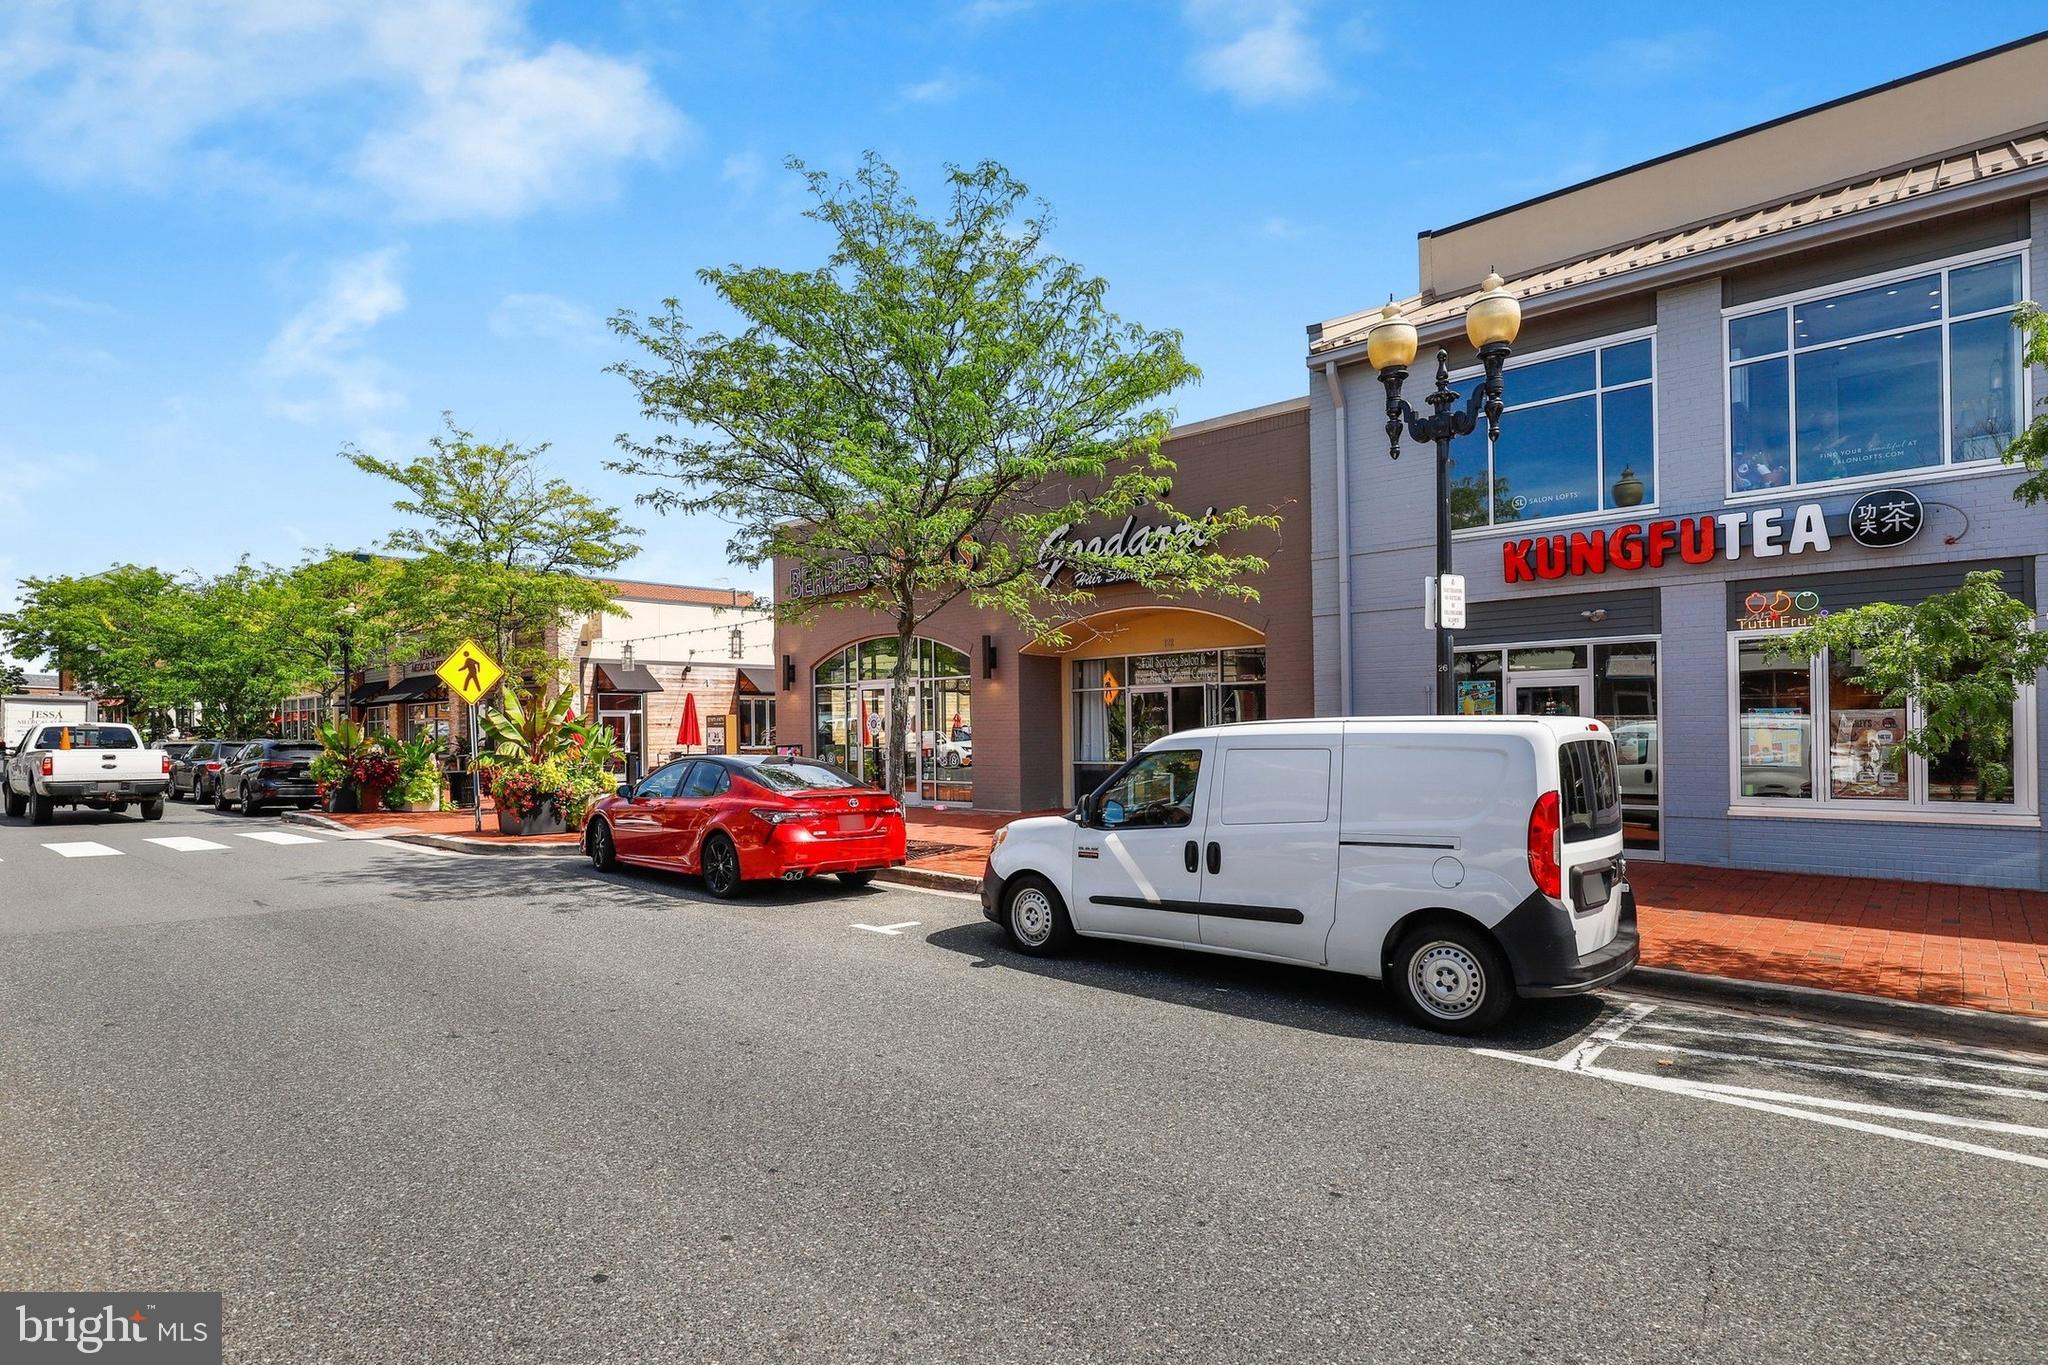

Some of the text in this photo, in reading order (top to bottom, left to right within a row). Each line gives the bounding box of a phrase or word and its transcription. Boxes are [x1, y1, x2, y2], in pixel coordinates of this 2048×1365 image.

[1832, 450, 1905, 466] SALONLOFTS.COM
[1840, 448, 1862, 456] YOUR
[1529, 495, 1553, 505] SALON
[1555, 491, 1578, 500] LOFTS
[1074, 571, 1102, 586] Hair
[1736, 616, 1777, 630] Tutti
[1141, 656, 1154, 669] Full
[1155, 655, 1179, 669] Service
[1180, 653, 1199, 667] Salon
[1438, 664, 1449, 672] 26
[31, 710, 63, 719] JESSA
